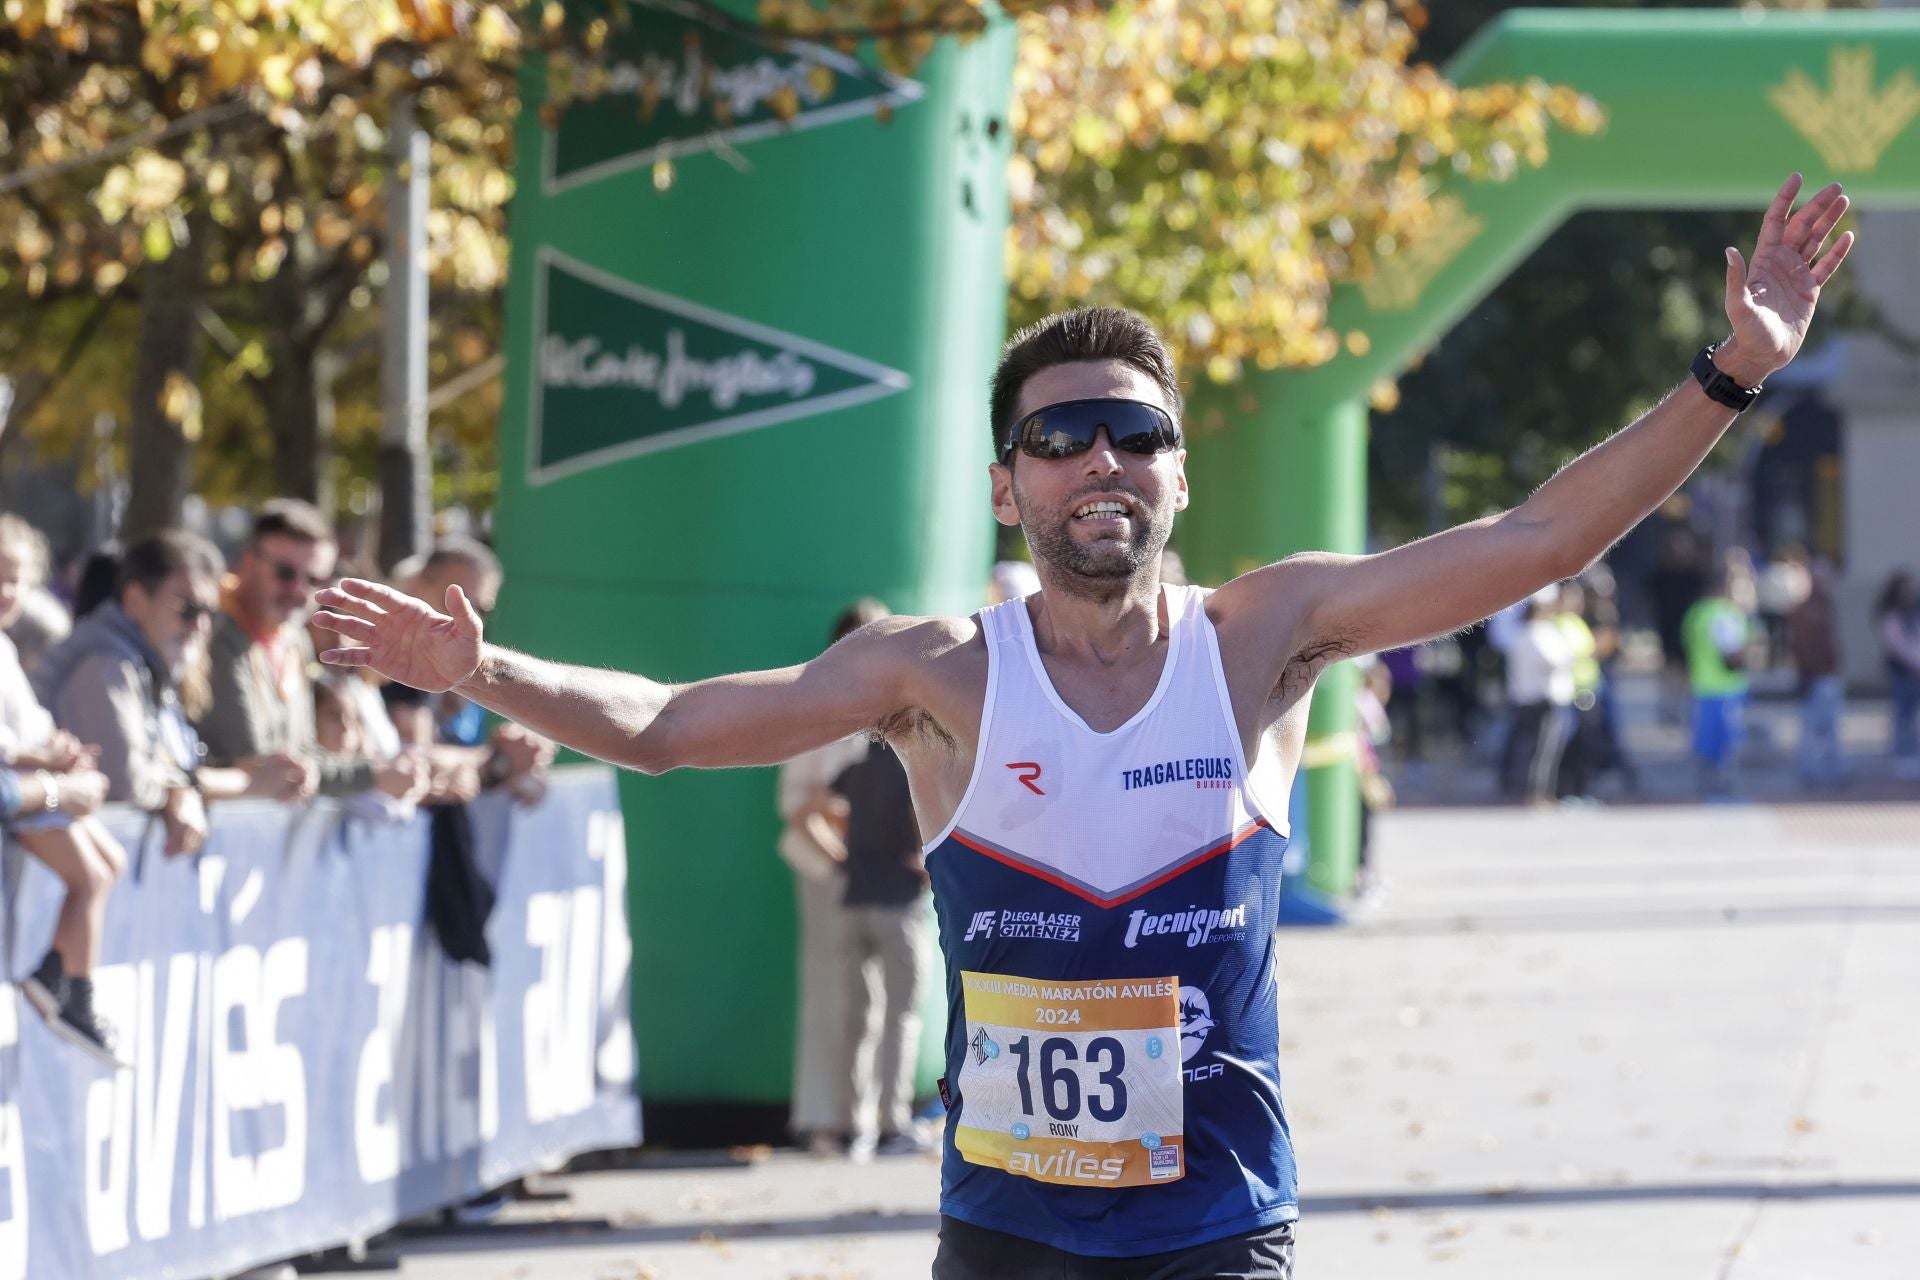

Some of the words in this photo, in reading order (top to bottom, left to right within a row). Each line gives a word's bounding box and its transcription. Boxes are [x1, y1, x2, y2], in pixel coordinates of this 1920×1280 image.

[1121, 757, 1232, 791] TRAGALEGUAS
[1196, 780, 1232, 789] BURGOS
[1208, 931, 1246, 944] DEPORTES
[1004, 982, 1038, 999] MEDIA
[1041, 983, 1117, 1000] MARATÓN
[1120, 981, 1174, 999] AVILÉS
[1035, 1007, 1080, 1025] 2024
[1009, 1035, 1128, 1123] 163
[1183, 1063, 1225, 1082] NCA
[1049, 1122, 1080, 1138] RONY
[1008, 1148, 1125, 1181] avilés
